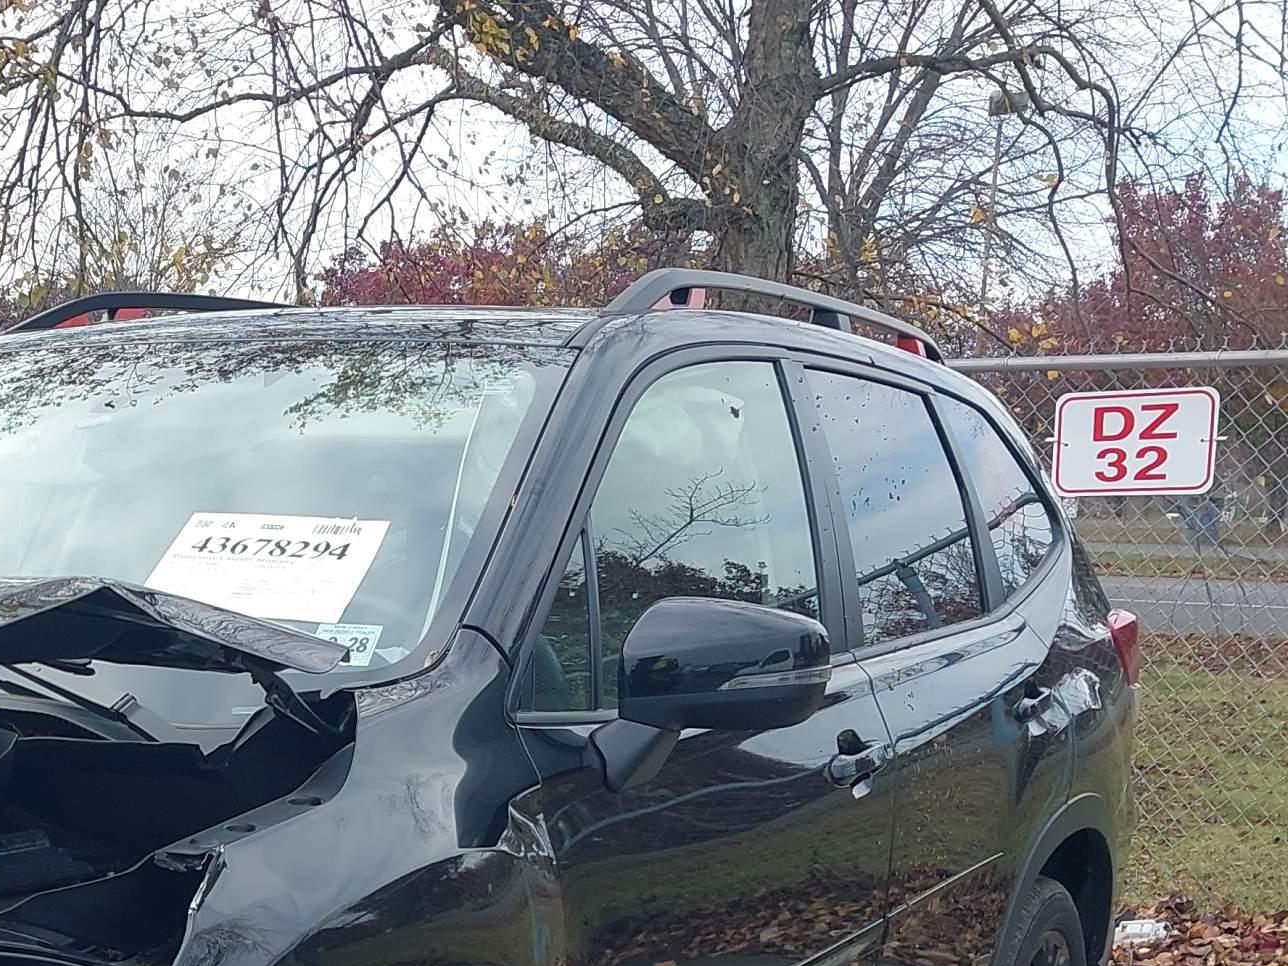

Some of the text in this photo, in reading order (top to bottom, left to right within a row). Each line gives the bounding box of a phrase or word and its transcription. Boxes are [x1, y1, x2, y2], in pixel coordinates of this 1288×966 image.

[1093, 403, 1179, 442] DZ
[1095, 446, 1168, 483] 32
[191, 536, 352, 560] 43678294
